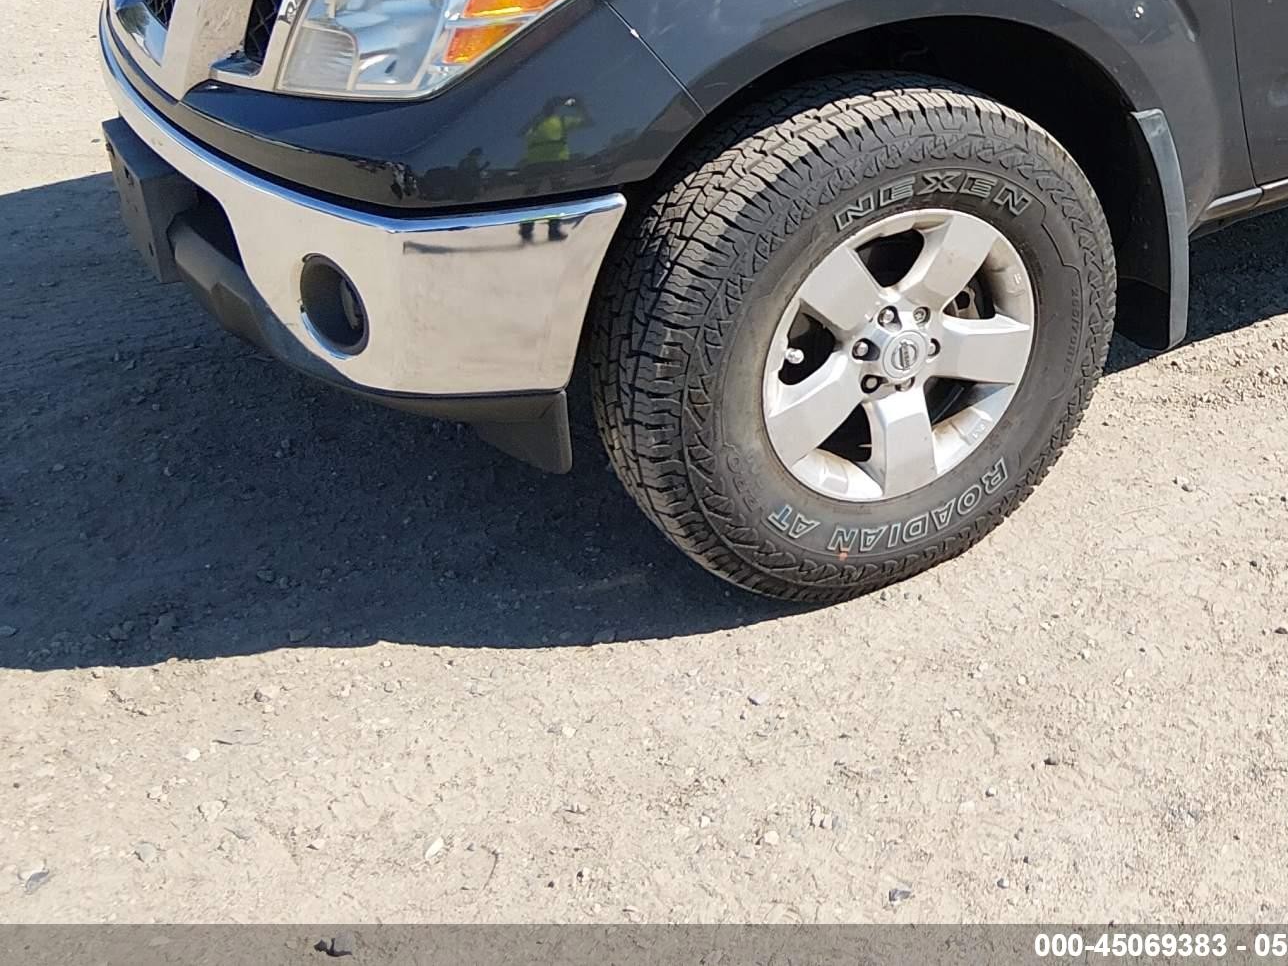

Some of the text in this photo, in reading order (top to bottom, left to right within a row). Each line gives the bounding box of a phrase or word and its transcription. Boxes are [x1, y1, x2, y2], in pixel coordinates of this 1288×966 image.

[834, 170, 1034, 231] NEXEN
[767, 504, 821, 540] AT
[827, 457, 1009, 553] ROADIAN
